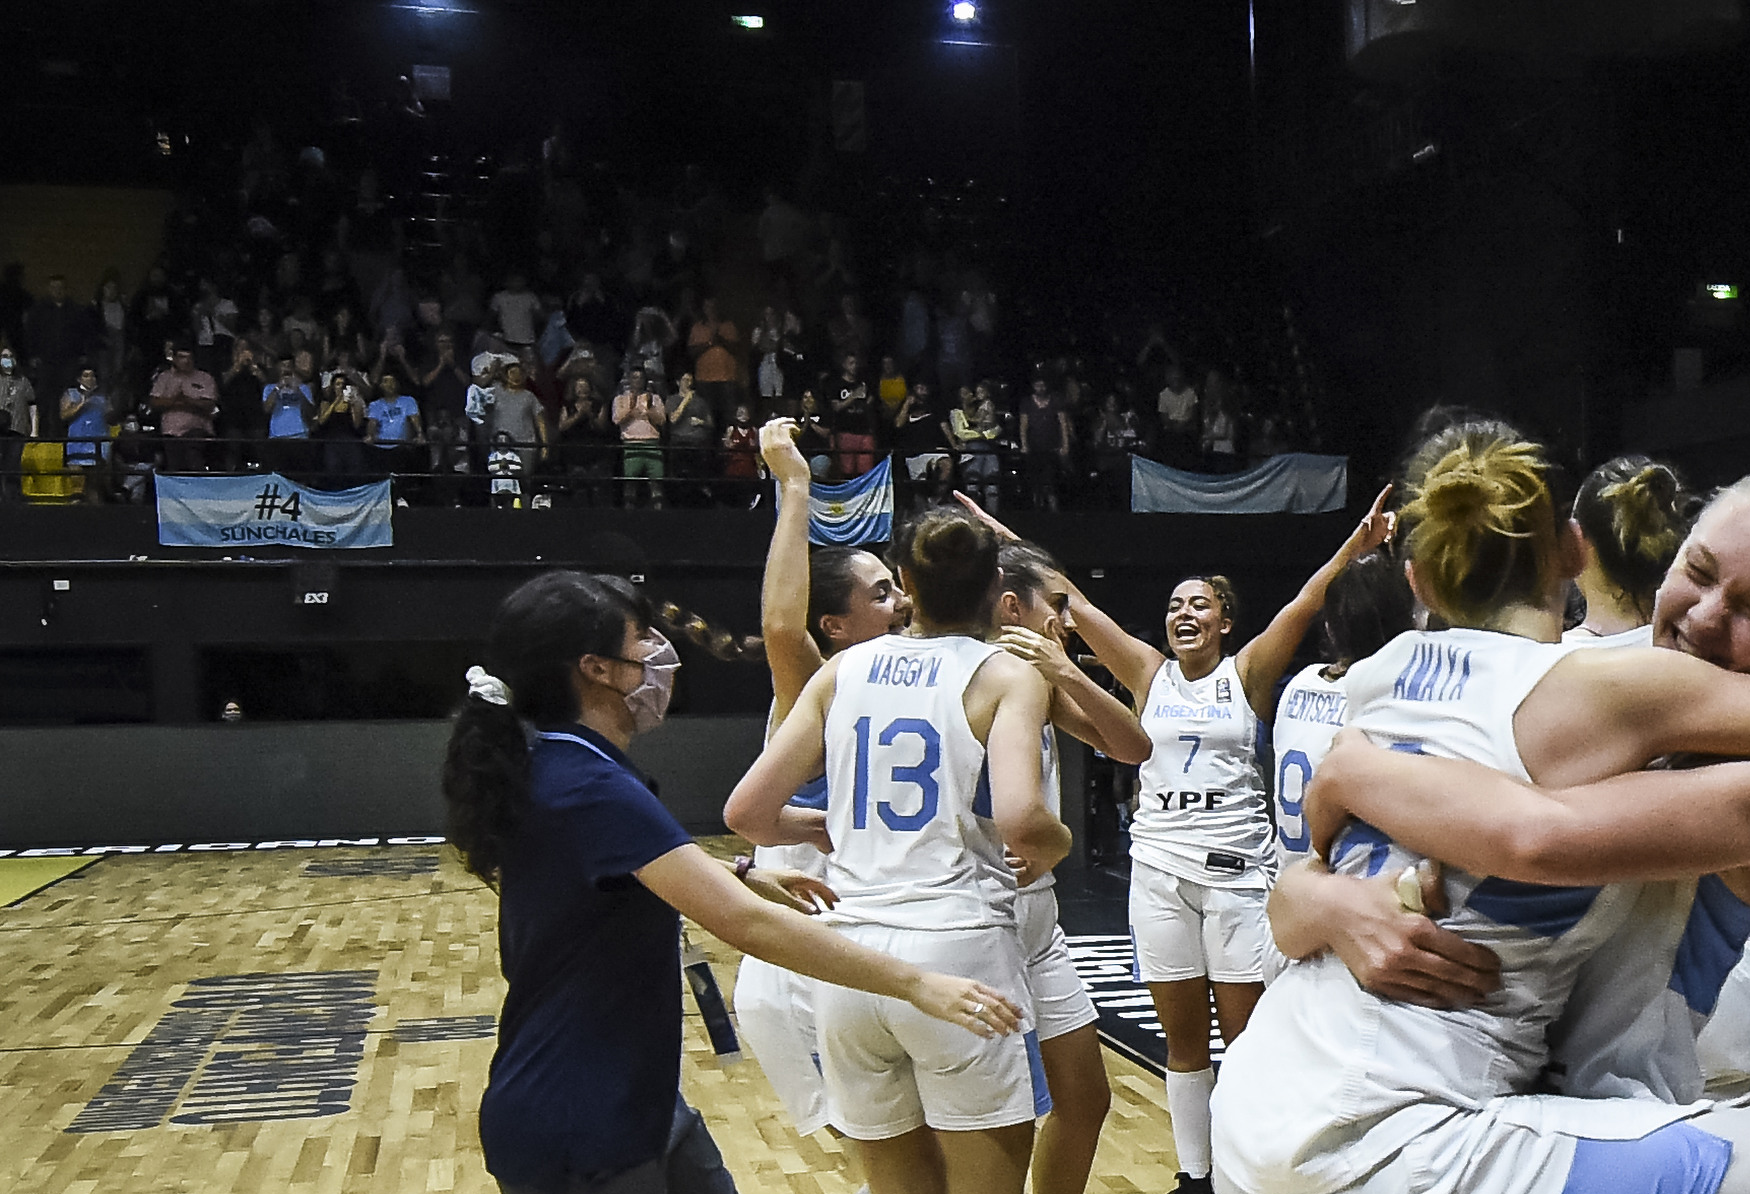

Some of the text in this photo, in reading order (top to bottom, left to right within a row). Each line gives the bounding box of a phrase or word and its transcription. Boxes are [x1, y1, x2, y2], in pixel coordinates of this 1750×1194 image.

[254, 483, 302, 521] #4
[220, 525, 337, 544] SUNCHALES
[1393, 643, 1472, 701] AMAYA
[1153, 704, 1233, 720] ARGENTINA
[1178, 735, 1201, 774] 7
[853, 716, 941, 832] 13
[1156, 791, 1226, 811] YPF
[1279, 749, 1313, 853] 9
[0, 836, 447, 858] ERICANO
